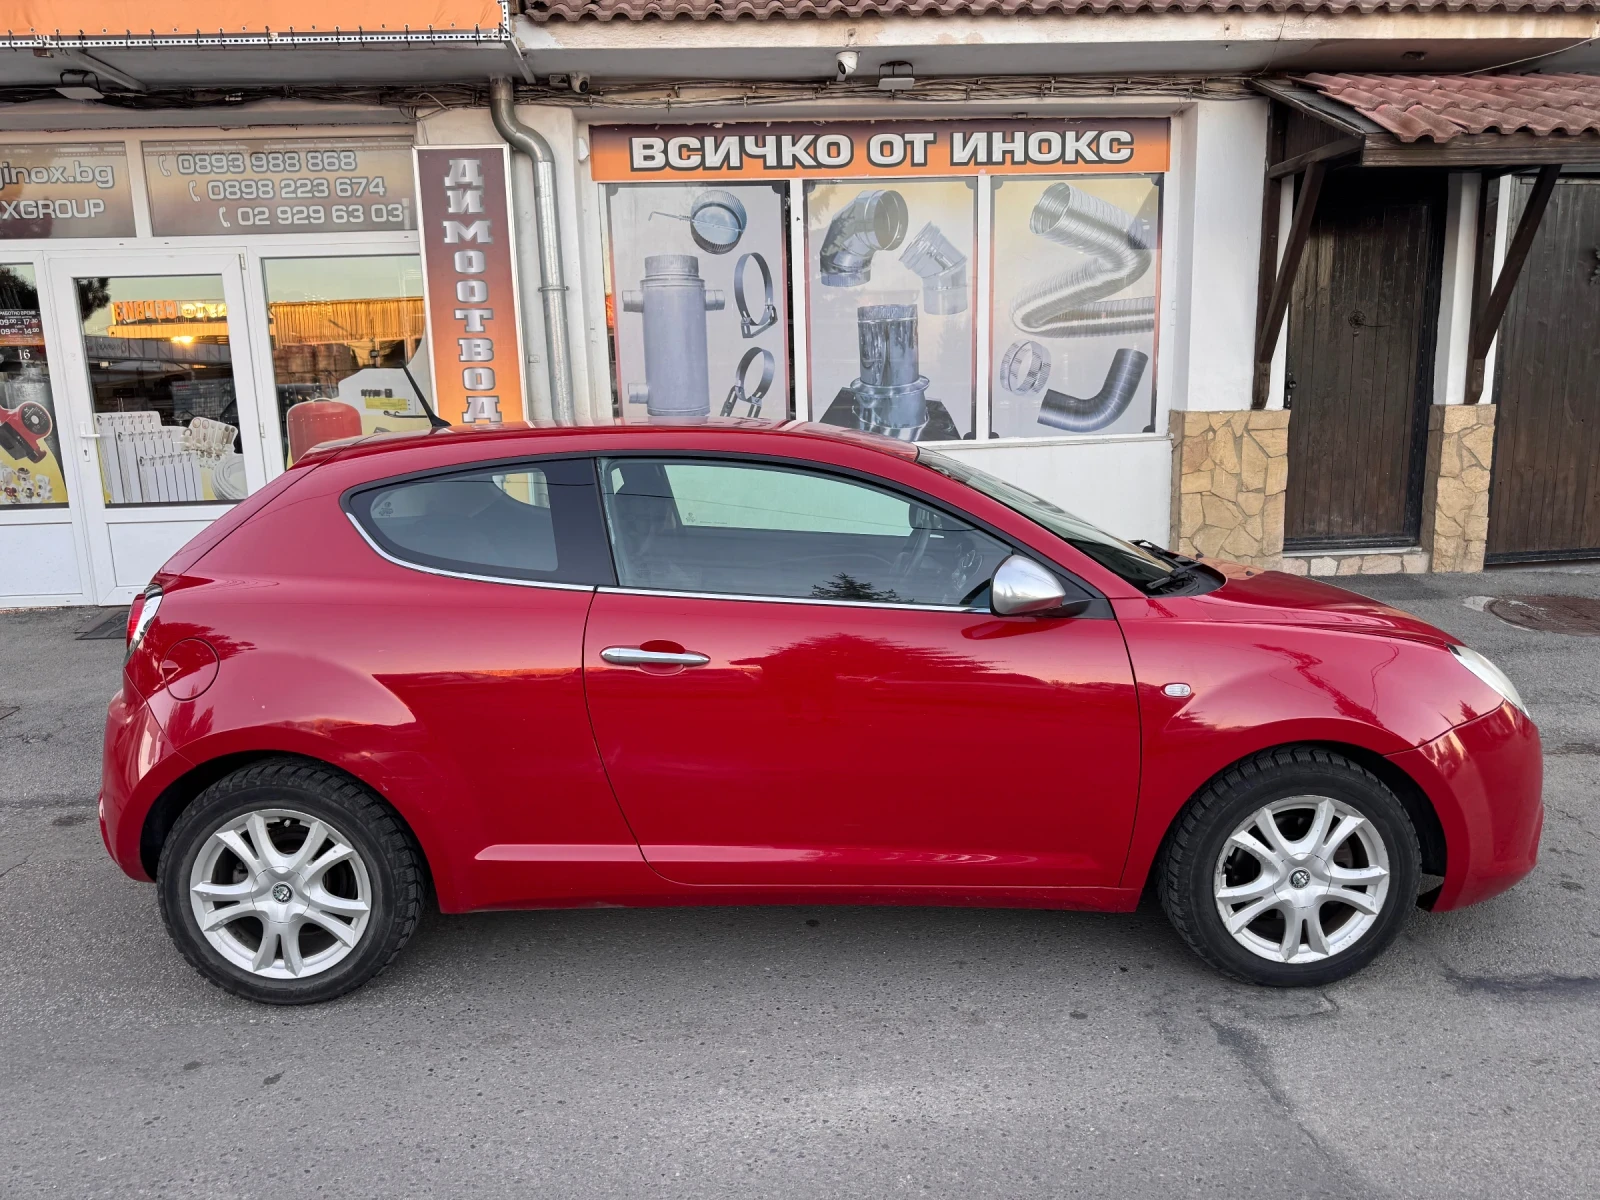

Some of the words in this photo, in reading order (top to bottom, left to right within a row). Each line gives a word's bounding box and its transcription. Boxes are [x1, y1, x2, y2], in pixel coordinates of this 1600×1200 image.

[177, 153, 246, 175] 0893
[250, 151, 301, 174] 988
[305, 150, 358, 171] 868
[630, 134, 853, 172] ВСИЧКО
[867, 132, 937, 167] ОТ
[950, 130, 1134, 166] ИНОКС
[207, 179, 274, 200] 0898
[280, 177, 329, 199] 223
[335, 176, 387, 198] 674
[237, 207, 271, 226] 02
[276, 206, 325, 225] 929
[331, 205, 365, 223] 63
[371, 204, 403, 222] 03
[443, 158, 502, 424] ДИМООТВОД
[18, 349, 30, 360] 16
